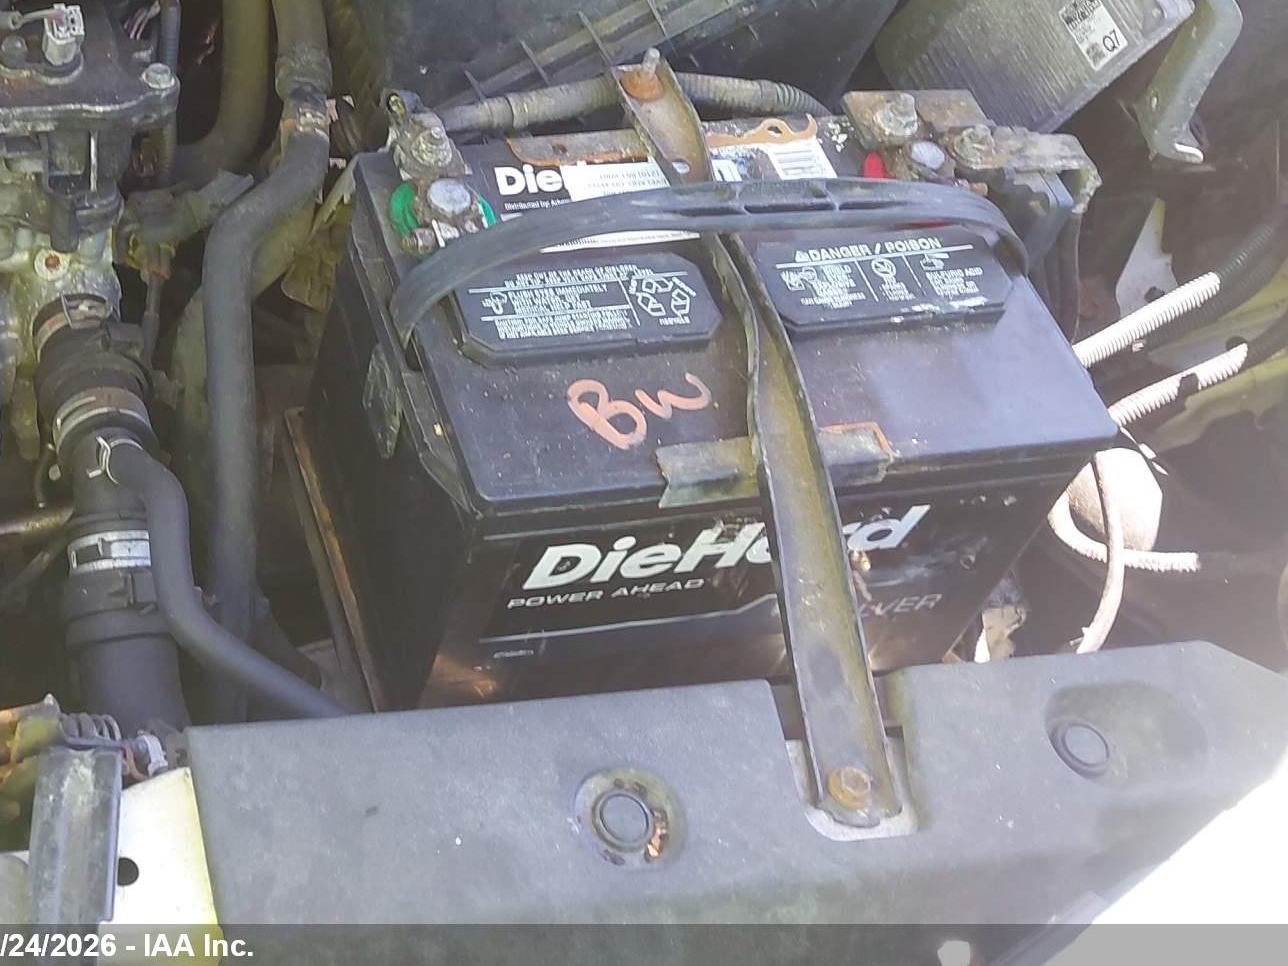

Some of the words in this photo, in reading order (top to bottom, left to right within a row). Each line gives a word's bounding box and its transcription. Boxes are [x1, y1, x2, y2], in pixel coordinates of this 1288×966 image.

[1102, 28, 1120, 52] Q7
[808, 244, 872, 261] DANGER
[885, 237, 943, 255] POISON
[507, 589, 604, 609] POWER
[610, 578, 704, 598] AHEAD
[858, 593, 943, 618] LVER
